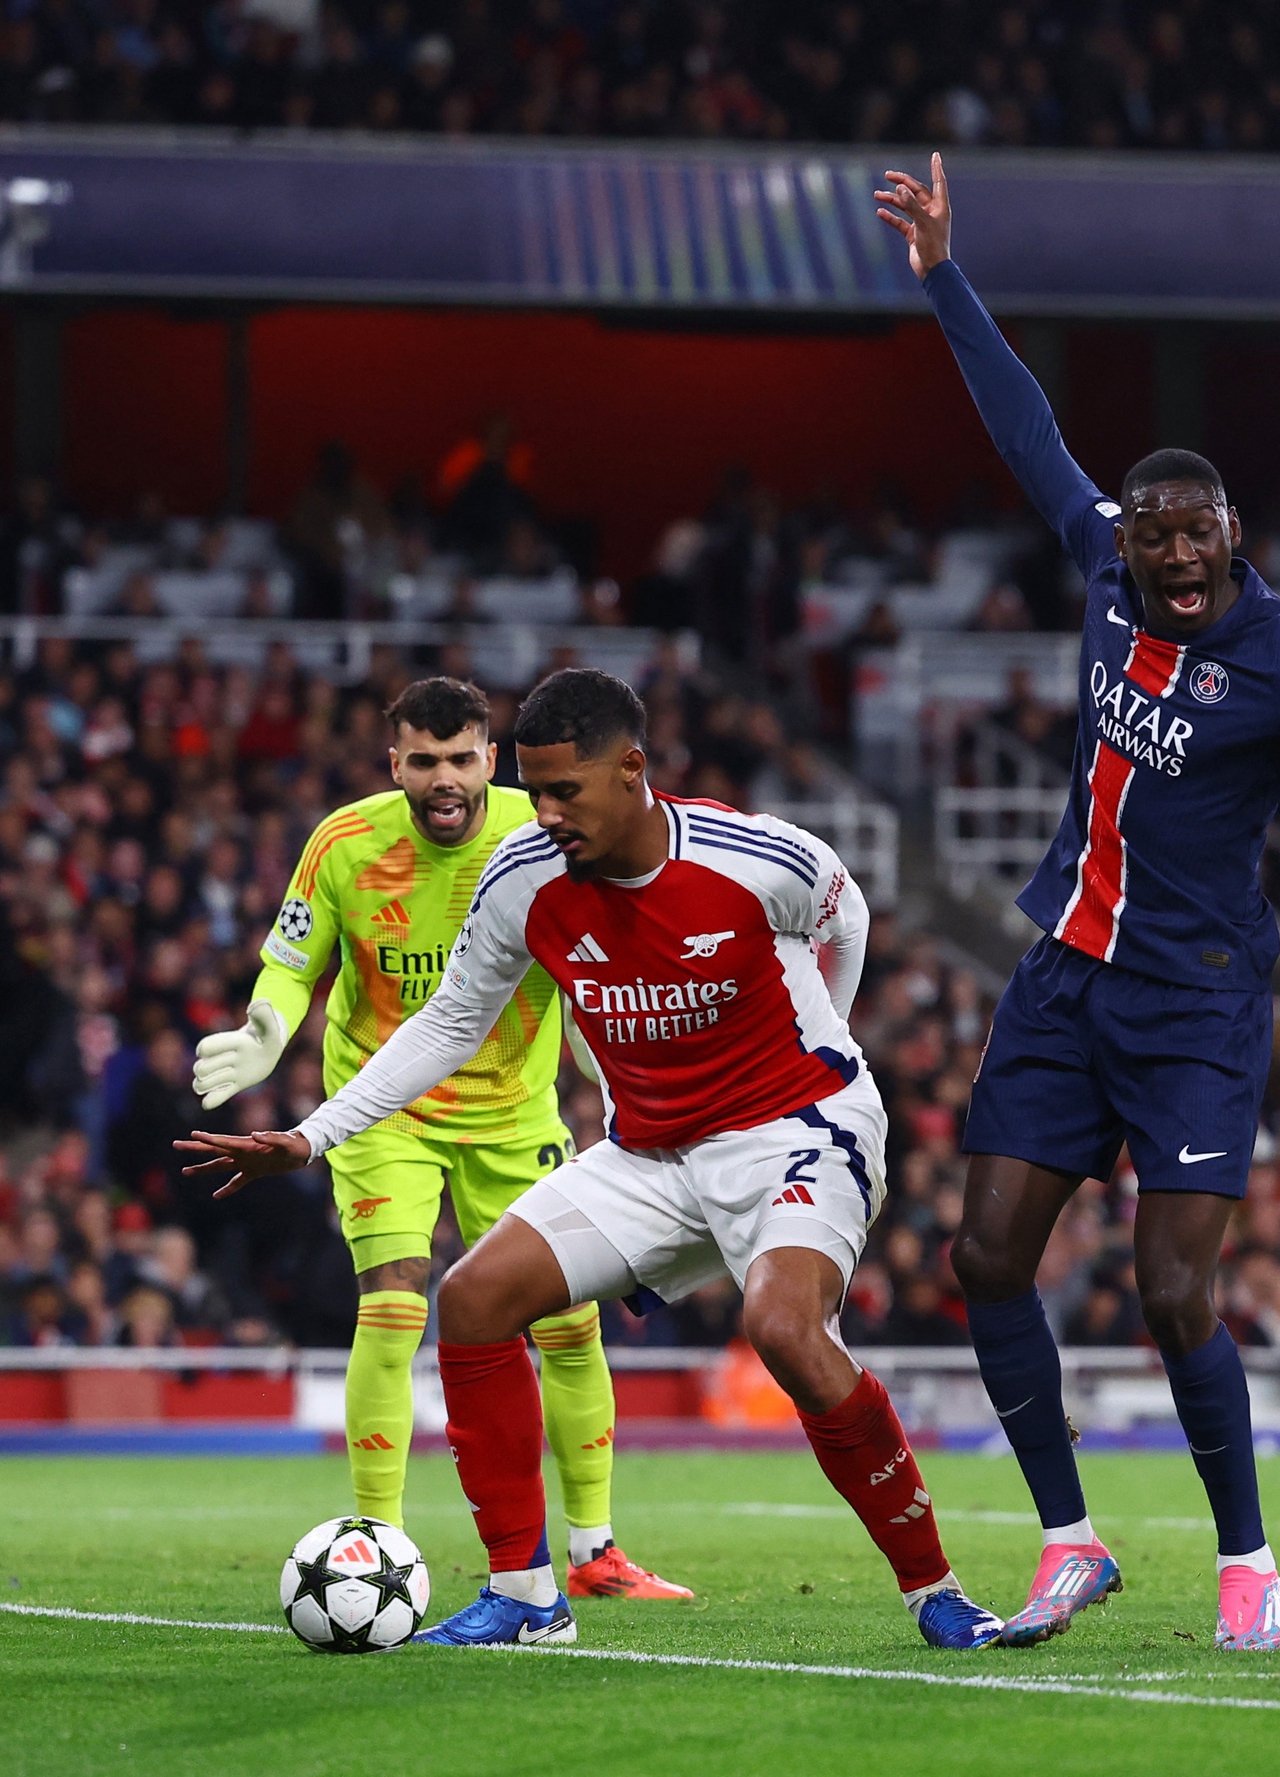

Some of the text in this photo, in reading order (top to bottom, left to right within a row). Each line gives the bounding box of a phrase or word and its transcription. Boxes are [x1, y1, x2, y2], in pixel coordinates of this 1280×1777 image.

[1200, 664, 1226, 680] PARIS
[1090, 661, 1194, 757] QATAR
[1097, 712, 1183, 777] AIRWAYS
[816, 866, 846, 929] RWAND
[819, 871, 838, 908] VISIT
[377, 943, 452, 974] Emi
[401, 978, 431, 1000] FLY
[572, 977, 739, 1013] Emirates
[605, 1007, 719, 1043] FLY BETTER
[784, 1149, 821, 1184] 2
[870, 1447, 907, 1486] AFC
